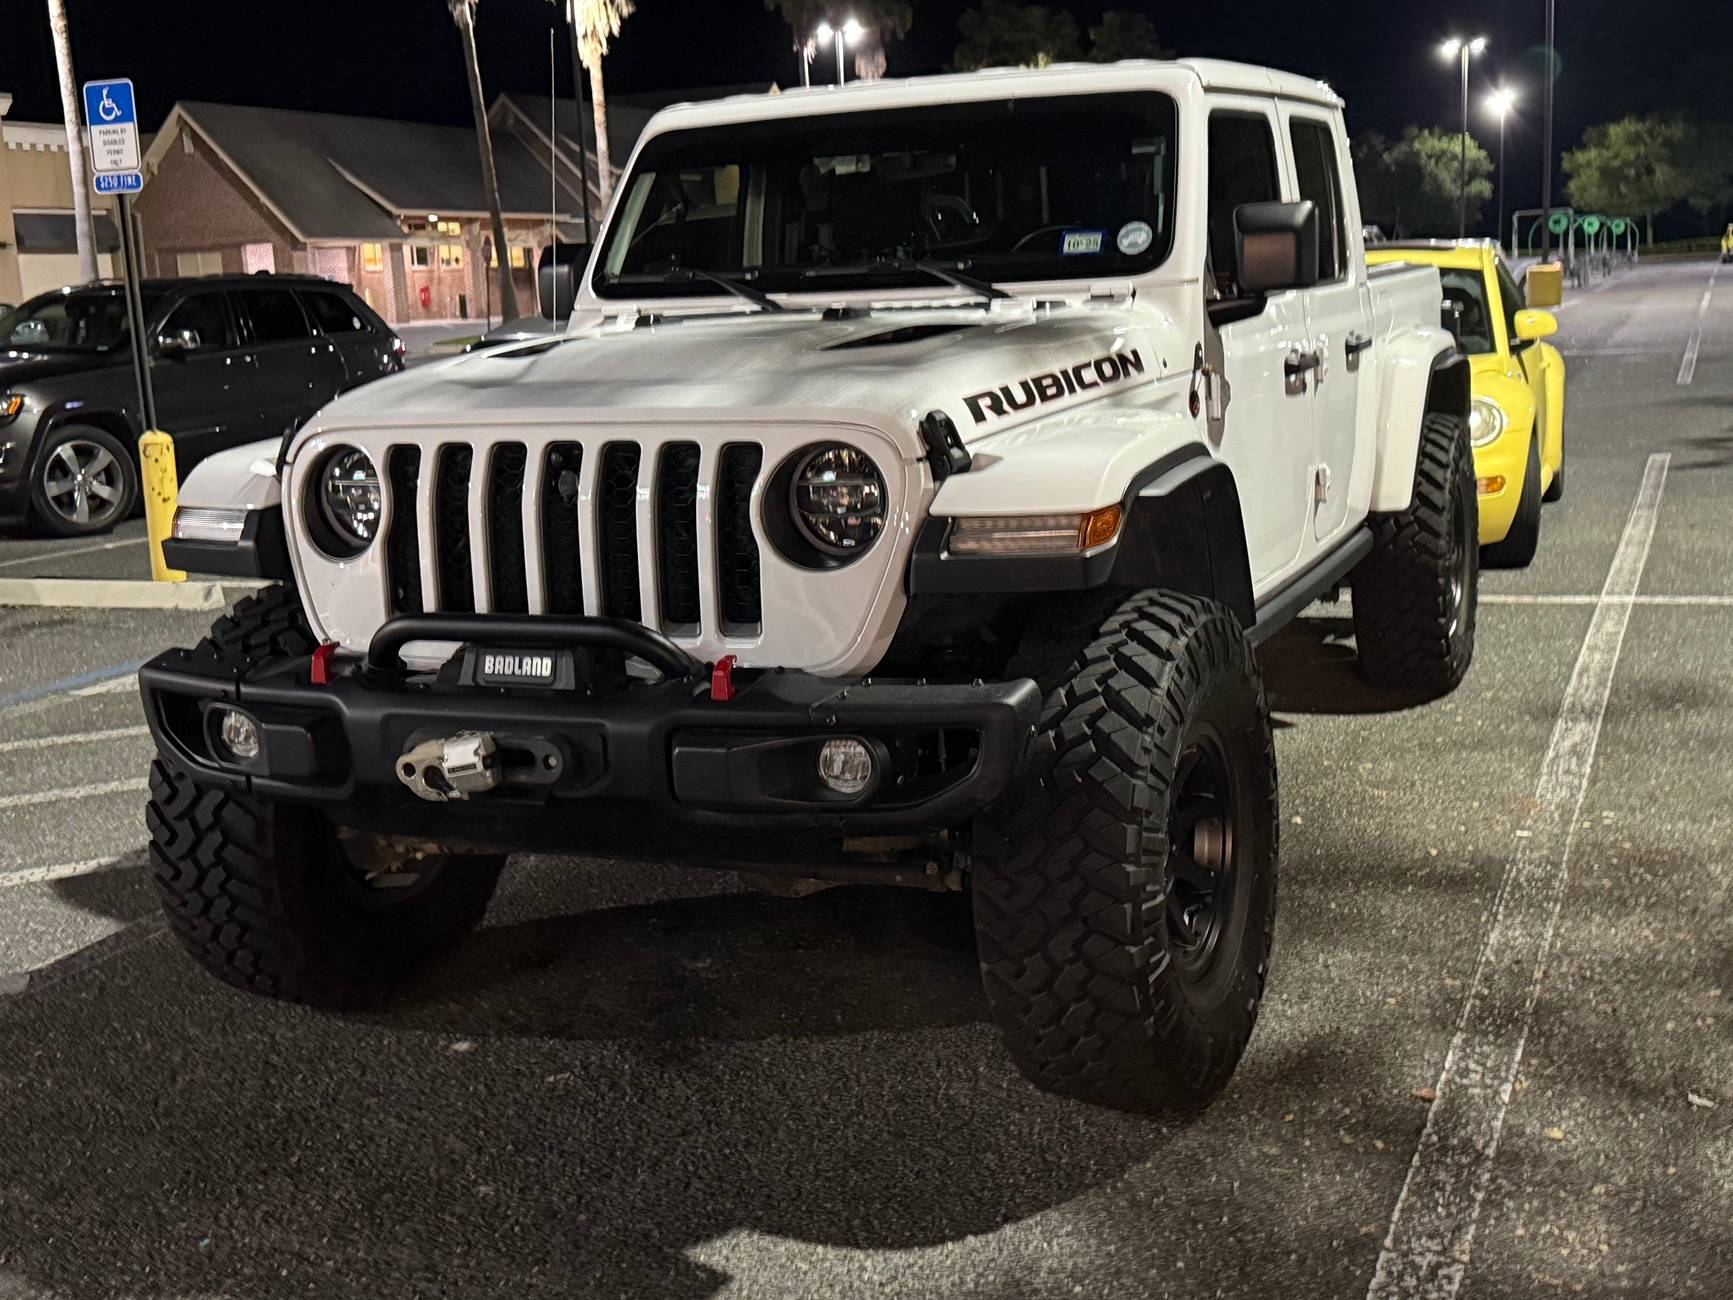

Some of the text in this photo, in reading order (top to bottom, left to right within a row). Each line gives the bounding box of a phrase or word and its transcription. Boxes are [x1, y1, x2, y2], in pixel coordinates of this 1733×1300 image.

[98, 127, 127, 136] PARKING BY
[102, 138, 125, 146] DISABLED
[99, 176, 118, 189] $250
[963, 349, 1145, 424] RUBICON
[484, 654, 552, 677] BADLAND
